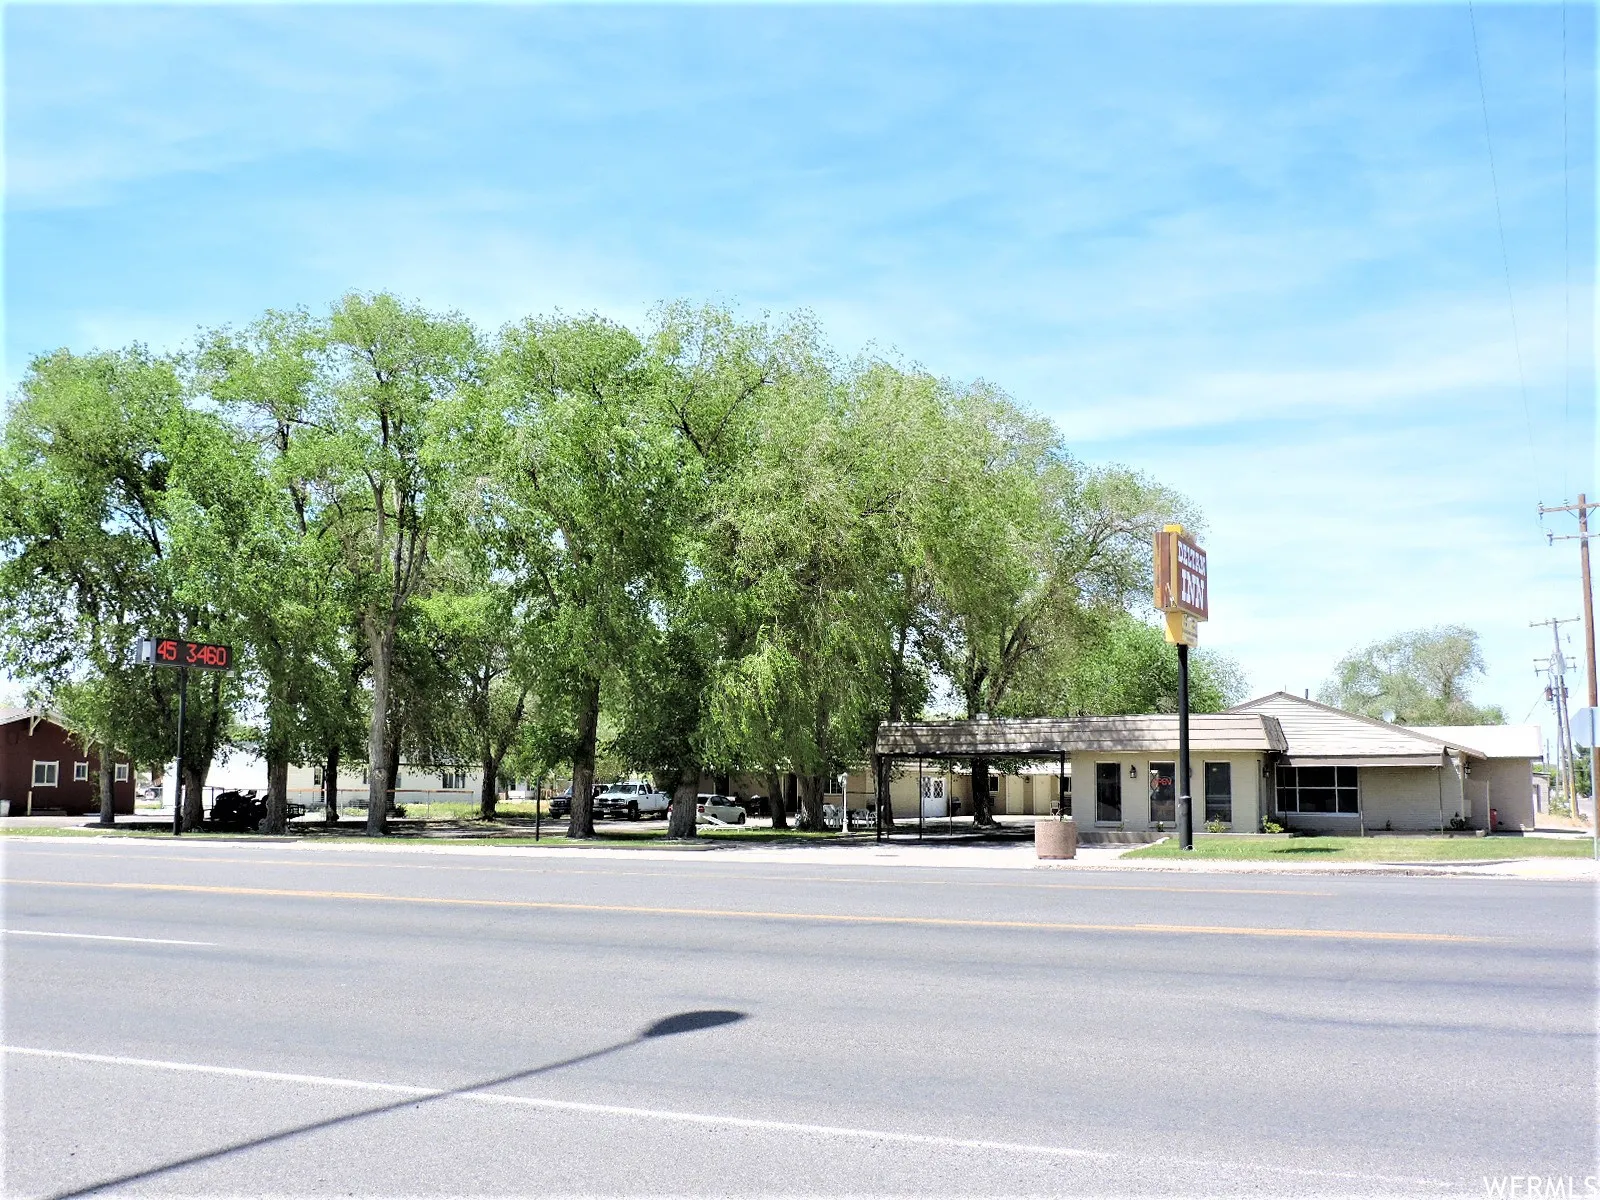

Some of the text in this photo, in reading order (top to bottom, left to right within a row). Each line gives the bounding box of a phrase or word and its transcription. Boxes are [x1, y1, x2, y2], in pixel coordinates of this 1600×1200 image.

[1181, 568, 1205, 610] INN
[157, 640, 226, 666] 45 3460
